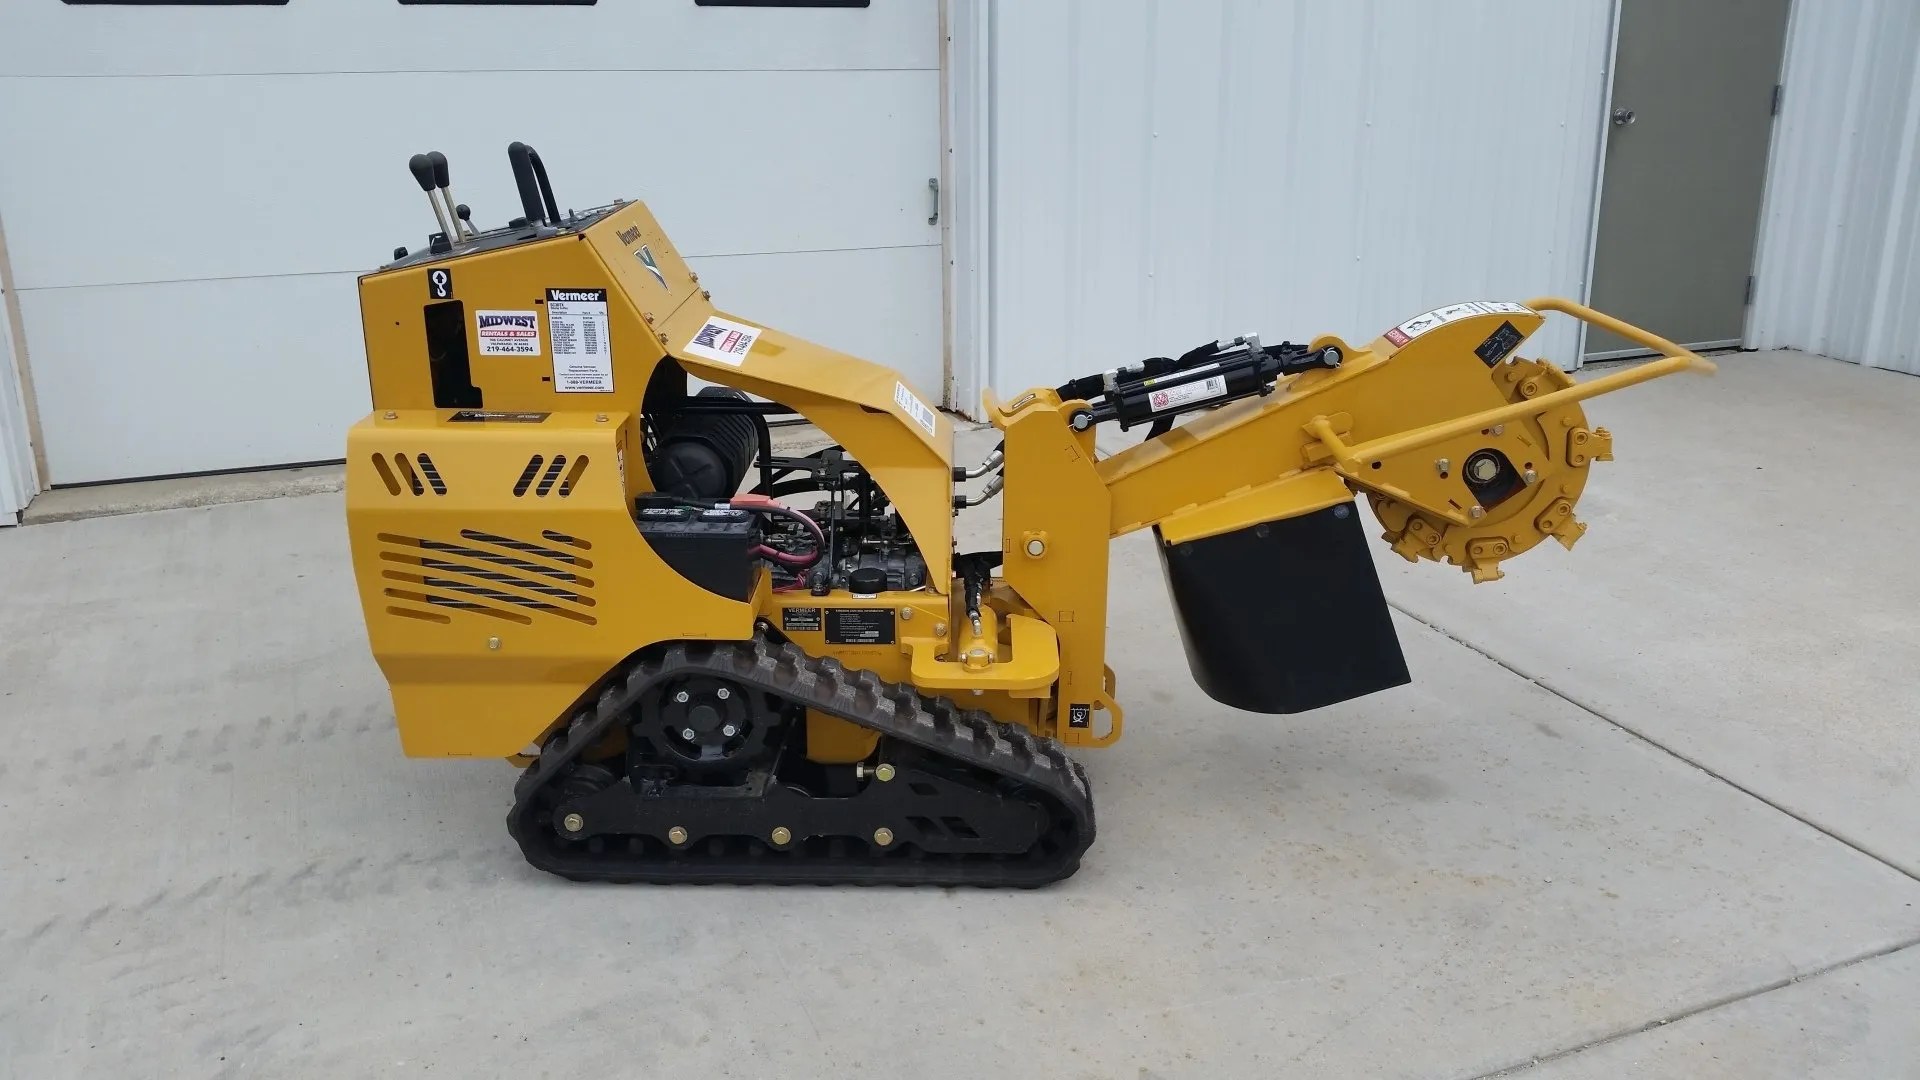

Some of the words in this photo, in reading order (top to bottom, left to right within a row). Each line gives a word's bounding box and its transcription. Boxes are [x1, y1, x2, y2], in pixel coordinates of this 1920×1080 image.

[616, 225, 641, 246] Vermeer
[551, 290, 599, 301] Vermeer
[479, 316, 535, 329] MIDWEST
